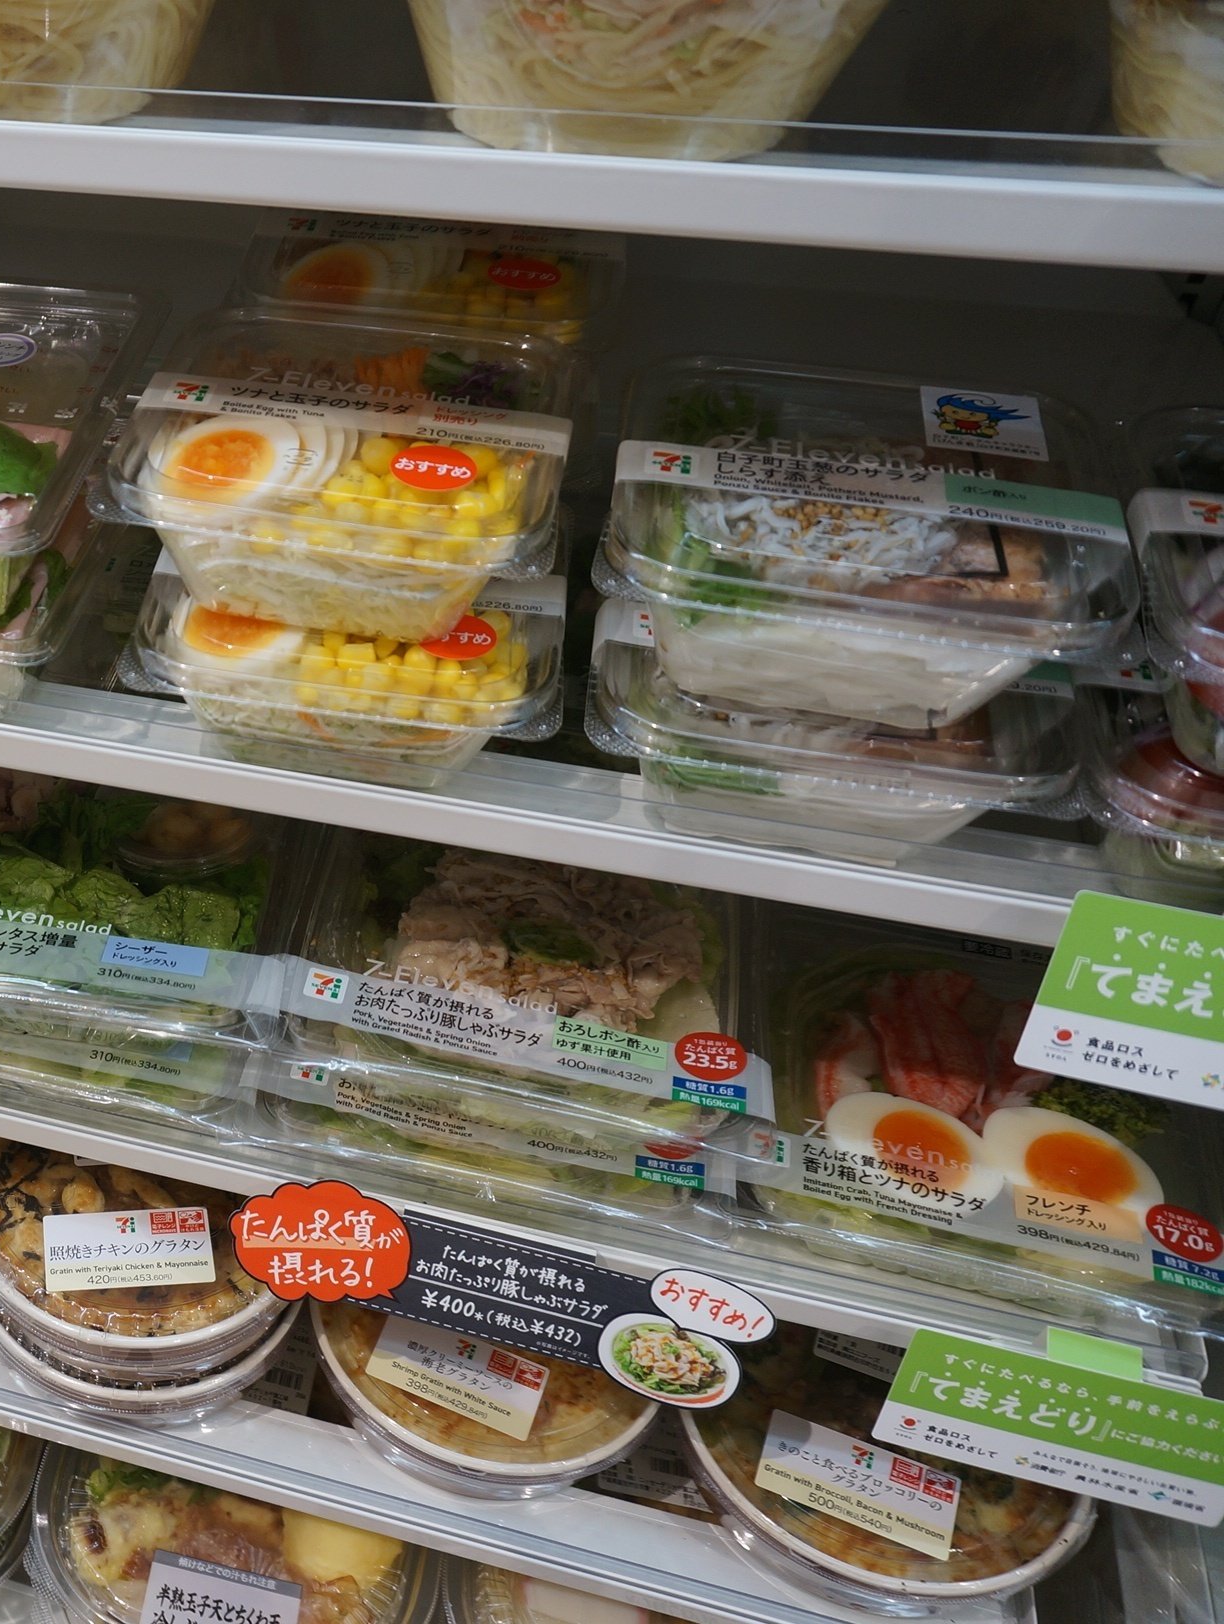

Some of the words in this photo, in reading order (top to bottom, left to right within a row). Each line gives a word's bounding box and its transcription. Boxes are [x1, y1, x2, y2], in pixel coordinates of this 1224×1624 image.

[231, 385, 415, 415] ツナと玉子のサラダ
[244, 366, 396, 398] 7-Eleven
[398, 387, 470, 406] salad
[302, 409, 325, 418] Tuna
[433, 413, 478, 426] 別売り
[395, 456, 471, 479] おすすめ
[716, 450, 929, 484] 白子町玉葱のサラダ
[725, 427, 908, 471] 7-Eleven
[913, 460, 996, 480] salad
[714, 473, 750, 484] Onion,
[716, 463, 831, 486] しらす添え
[753, 484, 788, 493] Sauce
[845, 493, 885, 506] Flakes
[56, 920, 113, 936] salad
[112, 951, 177, 968] ドレッシング入り
[115, 941, 168, 955] シーザー
[97, 967, 196, 991] 310円(税込334.80円)
[362, 957, 494, 1000] 7-Eleven
[497, 992, 557, 1014] salad
[1065, 952, 1224, 1020] 『てまえ
[358, 981, 494, 1020] たんぱく質が摂れる
[352, 1009, 375, 1022] Pork,
[377, 1014, 425, 1033] Vegetables
[434, 1029, 464, 1043] Spring
[466, 1036, 491, 1048] Onion
[354, 994, 544, 1048] お肉たっぷり豚しゃぶサラダ
[351, 1015, 370, 1026] with
[372, 1021, 401, 1033] Grated
[402, 1027, 432, 1041] Radish
[442, 1038, 470, 1051] Ponzu
[472, 1044, 498, 1057] Sauce
[556, 1038, 632, 1061] ゆず果汁使用
[558, 1020, 661, 1055] おろしポン酢入り
[1087, 1036, 1145, 1058] 食品ロス
[89, 1049, 181, 1076] 310円(税込334.80円)
[556, 1057, 654, 1085] 400円(税込432円)
[682, 1051, 738, 1070] 23.5g
[1082, 1051, 1179, 1080] ゼロをめざして
[679, 1091, 740, 1111] 熱量169kcal
[685, 1081, 735, 1096] 糖質1.6g
[360, 1096, 403, 1116] Vegetables
[527, 1139, 618, 1162] 400円(税込432円)
[802, 1143, 939, 1183] たんぱく質が摂れる
[641, 1171, 699, 1188] 熱量169kcal
[647, 1160, 694, 1174] 糖質1.6g
[802, 1156, 988, 1212] 香り箱とツナのサラダ
[803, 1176, 844, 1191] Imitation
[846, 1185, 871, 1197] Crab,
[874, 1191, 895, 1203] Tuna
[897, 1196, 953, 1217] Mayonnaise
[803, 1184, 832, 1197] Boiled
[834, 1191, 852, 1202] Egg
[854, 1194, 875, 1205] with
[876, 1201, 908, 1214] French
[910, 1209, 954, 1226] Dressing
[1026, 1195, 1091, 1216] フレンチ
[1026, 1207, 1107, 1232] ドレッシング入り
[241, 1208, 404, 1250] たんぱく質が
[1016, 1224, 1140, 1262] 398円(税込429.84円)
[1152, 1223, 1216, 1253] 17.0g
[49, 1238, 206, 1262] 照焼きチキンのグラタン
[50, 1267, 74, 1275] Gratin
[75, 1266, 91, 1274] with
[93, 1264, 124, 1274] Teriyaki
[125, 1262, 155, 1271] Chicken
[165, 1260, 209, 1269] Mayonnaise
[87, 1273, 173, 1285] 420円(税込453.60円)
[267, 1251, 374, 1288] 摂れる!
[442, 1244, 586, 1294] たんぱく質が摂れる
[415, 1258, 609, 1320] お肉たっぷり豚しゃぶサラダ
[660, 1277, 765, 1339] おすすめ!
[406, 1339, 513, 1391] 濃厚クリーミーソースの
[420, 1356, 492, 1392] 海老グラタン
[391, 1360, 419, 1378] Shrimp
[420, 1373, 444, 1387] Gratin
[445, 1384, 462, 1396] with
[463, 1391, 486, 1405] White
[487, 1402, 512, 1417] Sauce
[405, 1377, 488, 1420] 398円(税込429.84円)
[923, 1433, 999, 1459] ゼロをめざして
[926, 1424, 971, 1442] 食品ロス
[777, 1440, 943, 1512] きのこと食べるブロッコリーの
[831, 1473, 882, 1498] グラタン
[764, 1463, 792, 1478] Gratin
[794, 1475, 813, 1488] with
[815, 1483, 853, 1505] Broccoli,
[856, 1500, 884, 1516] Bacon
[895, 1515, 946, 1541] Mushroom
[807, 1491, 893, 1534] 500円(税込540円)
[178, 1556, 277, 1590] 傾けなどでの汁もれ注意
